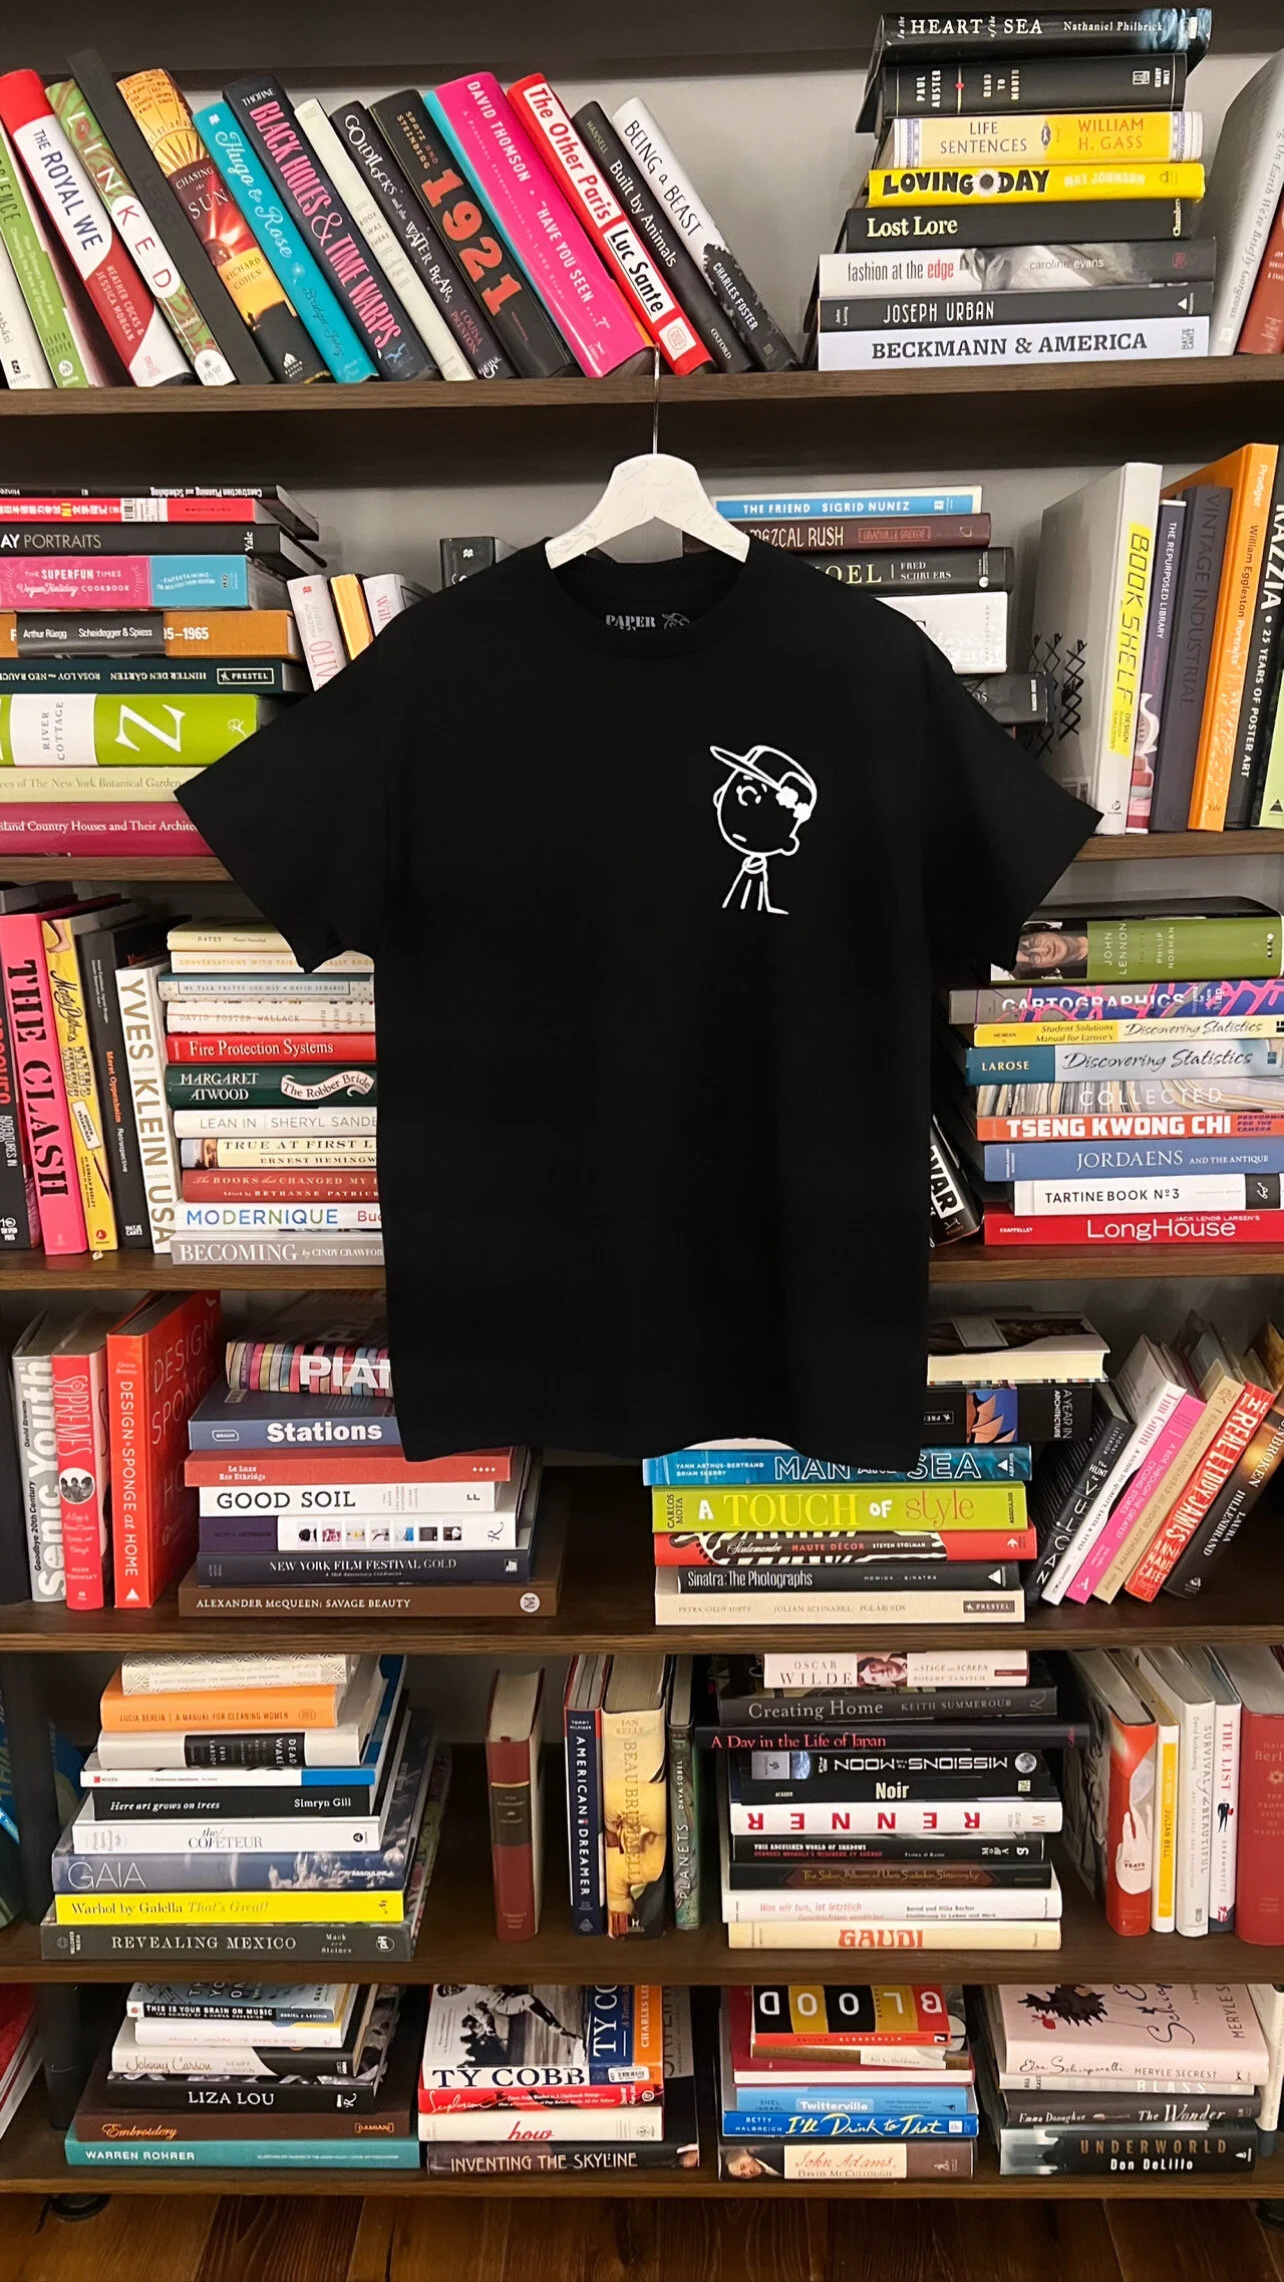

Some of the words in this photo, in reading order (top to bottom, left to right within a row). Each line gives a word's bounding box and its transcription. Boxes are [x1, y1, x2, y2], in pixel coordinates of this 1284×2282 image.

[911, 19, 983, 35] HEART
[1003, 19, 1043, 34] SEA
[1064, 21, 1113, 31] Nathaniel
[1117, 20, 1162, 32] Philbrick
[250, 101, 302, 163] BLACK
[467, 81, 496, 119] DAVID
[490, 118, 531, 183] THOMSON
[969, 122, 998, 135] LIFE
[1078, 118, 1144, 132] WILLIAM
[32, 129, 51, 150] THE
[940, 138, 1027, 153] SENTENCES
[1078, 136, 1095, 150] H.
[1101, 134, 1143, 149] GASS
[527, 87, 553, 118] The
[549, 123, 584, 171] Other
[578, 171, 610, 220] Paris
[41, 151, 80, 216] ROYAL
[281, 155, 331, 216] HOLES
[625, 120, 662, 175] BEING
[659, 175, 668, 185] a
[664, 186, 702, 236] BEAST
[882, 171, 973, 195] LOVING
[998, 170, 1050, 193] DAY
[610, 160, 634, 193] Built
[631, 194, 645, 214] by
[641, 214, 677, 268] Animals
[74, 216, 103, 251] WE
[311, 214, 343, 243] &
[867, 217, 910, 238] Lost
[913, 216, 958, 235] Lore
[421, 169, 521, 315] 1921
[325, 234, 356, 288] TIME
[609, 229, 630, 260] Luc
[628, 260, 664, 314] Sante
[847, 263, 888, 283] fashion
[892, 263, 903, 281] at
[906, 262, 924, 280] the
[927, 263, 954, 282] edge
[712, 262, 741, 299] CHARLES
[733, 296, 758, 331] FOSTER
[348, 281, 401, 348] WARPS
[883, 304, 938, 323] JOSEPH
[946, 301, 994, 319] URBAN
[710, 328, 732, 360] OXFORD
[872, 338, 1007, 359] BECKMANN
[1016, 336, 1032, 353] &
[1039, 333, 1147, 353] AMERICA
[743, 504, 764, 514] THE
[768, 503, 810, 513] FRIEND
[822, 502, 864, 512] SIGRID
[868, 501, 910, 511] NUNEZ
[24, 535, 101, 548] PORTRAITS
[244, 531, 254, 552] Yale
[1126, 532, 1149, 607] BOOK
[605, 614, 656, 629] PAPER
[1262, 628, 1272, 643] 25
[1116, 617, 1140, 705] SHELF
[1256, 647, 1269, 683] YEARS
[231, 672, 268, 680] PRESTEL
[1253, 687, 1262, 704] OF
[1246, 707, 1260, 750] POSTER
[1241, 753, 1251, 778] ART
[7, 959, 46, 1042] THE
[120, 977, 153, 1061] YVES
[190, 1040, 214, 1055] Fire
[218, 1041, 280, 1056] Protection
[283, 1039, 333, 1056] Systems
[982, 1060, 1029, 1071] LAROSE
[1063, 1049, 1166, 1070] Discovering
[1171, 1050, 1253, 1066] Statistics
[180, 1073, 259, 1086] MARGARET
[190, 1088, 249, 1100] ATWOOD
[22, 1060, 68, 1196] CLASH
[133, 1078, 167, 1168] KLEIN
[1007, 1119, 1084, 1137] TSENG
[1092, 1118, 1184, 1135] KWONG
[1191, 1116, 1231, 1134] CHI
[224, 1140, 270, 1150] TRUE
[278, 1140, 298, 1149] AT
[306, 1139, 355, 1149] FIRST
[1076, 1151, 1183, 1171] JORDAENS
[1045, 1191, 1103, 1204] TARTINE
[1107, 1189, 1148, 1201] BOOK
[1172, 1189, 1180, 1198] 3
[147, 1188, 177, 1244] USA
[187, 1208, 338, 1225] MODERNIQUE
[1087, 1220, 1236, 1241] LongHouse
[180, 1244, 297, 1263] BECOMING
[267, 1422, 382, 1443] Stations
[217, 1493, 290, 1509] GOOD
[301, 1491, 356, 1508] SOIL
[698, 1501, 714, 1519] A
[724, 1495, 860, 1526] TOUCH
[869, 1501, 892, 1518] OF
[905, 1491, 974, 1527] style
[124, 1515, 134, 1529] at
[124, 1533, 138, 1576] HOME
[688, 1571, 726, 1586] Sinatra:
[728, 1571, 745, 1586] The
[748, 1570, 812, 1587] Photographs
[197, 1599, 262, 1608] ALEXANDER
[325, 1599, 365, 1608] SAVAGE
[368, 1599, 410, 1608] BEAUTY
[749, 1703, 824, 1719] Creating
[830, 1701, 883, 1715] Home
[711, 1736, 721, 1747] A
[727, 1735, 754, 1751] Day
[760, 1736, 772, 1747] in
[778, 1735, 800, 1747] the
[804, 1734, 830, 1747] Life
[833, 1734, 849, 1747] of
[851, 1734, 886, 1750] Japan
[1223, 1721, 1232, 1751] THE
[835, 1758, 897, 1770] MOON
[908, 1757, 1008, 1770] MISSIONS
[576, 1736, 588, 1816] AMERICAN
[1221, 1760, 1231, 1792] LIST
[876, 1783, 909, 1799] Noir
[111, 1801, 133, 1811] Here
[136, 1801, 150, 1810] art
[152, 1802, 181, 1812] grows
[197, 1801, 219, 1809] trees
[295, 1798, 329, 1809] Simryn
[333, 1797, 351, 1807] Gill
[578, 1829, 590, 1896] DREAMER
[677, 1824, 689, 1901] PLANETS
[68, 1862, 146, 1888] GAIA
[112, 1936, 218, 1949] REVEALING
[226, 1936, 296, 1949] MEXICO
[838, 1929, 923, 1947] GAUDI
[432, 2070, 478, 2087] TY
[491, 2068, 585, 2087] COBB
[188, 2092, 231, 2105] LIZA
[237, 2093, 274, 2105] LOU
[86, 2150, 138, 2160] WARREN
[144, 2152, 194, 2160] ROHRER
[1081, 2140, 1227, 2154] UNDERWORLD
[451, 2154, 532, 2172] INVENTING
[539, 2154, 566, 2169] THE
[574, 2152, 638, 2169] SKYLINE
[1111, 2160, 1134, 2170] Don
[1144, 2158, 1193, 2170] DeLillo
